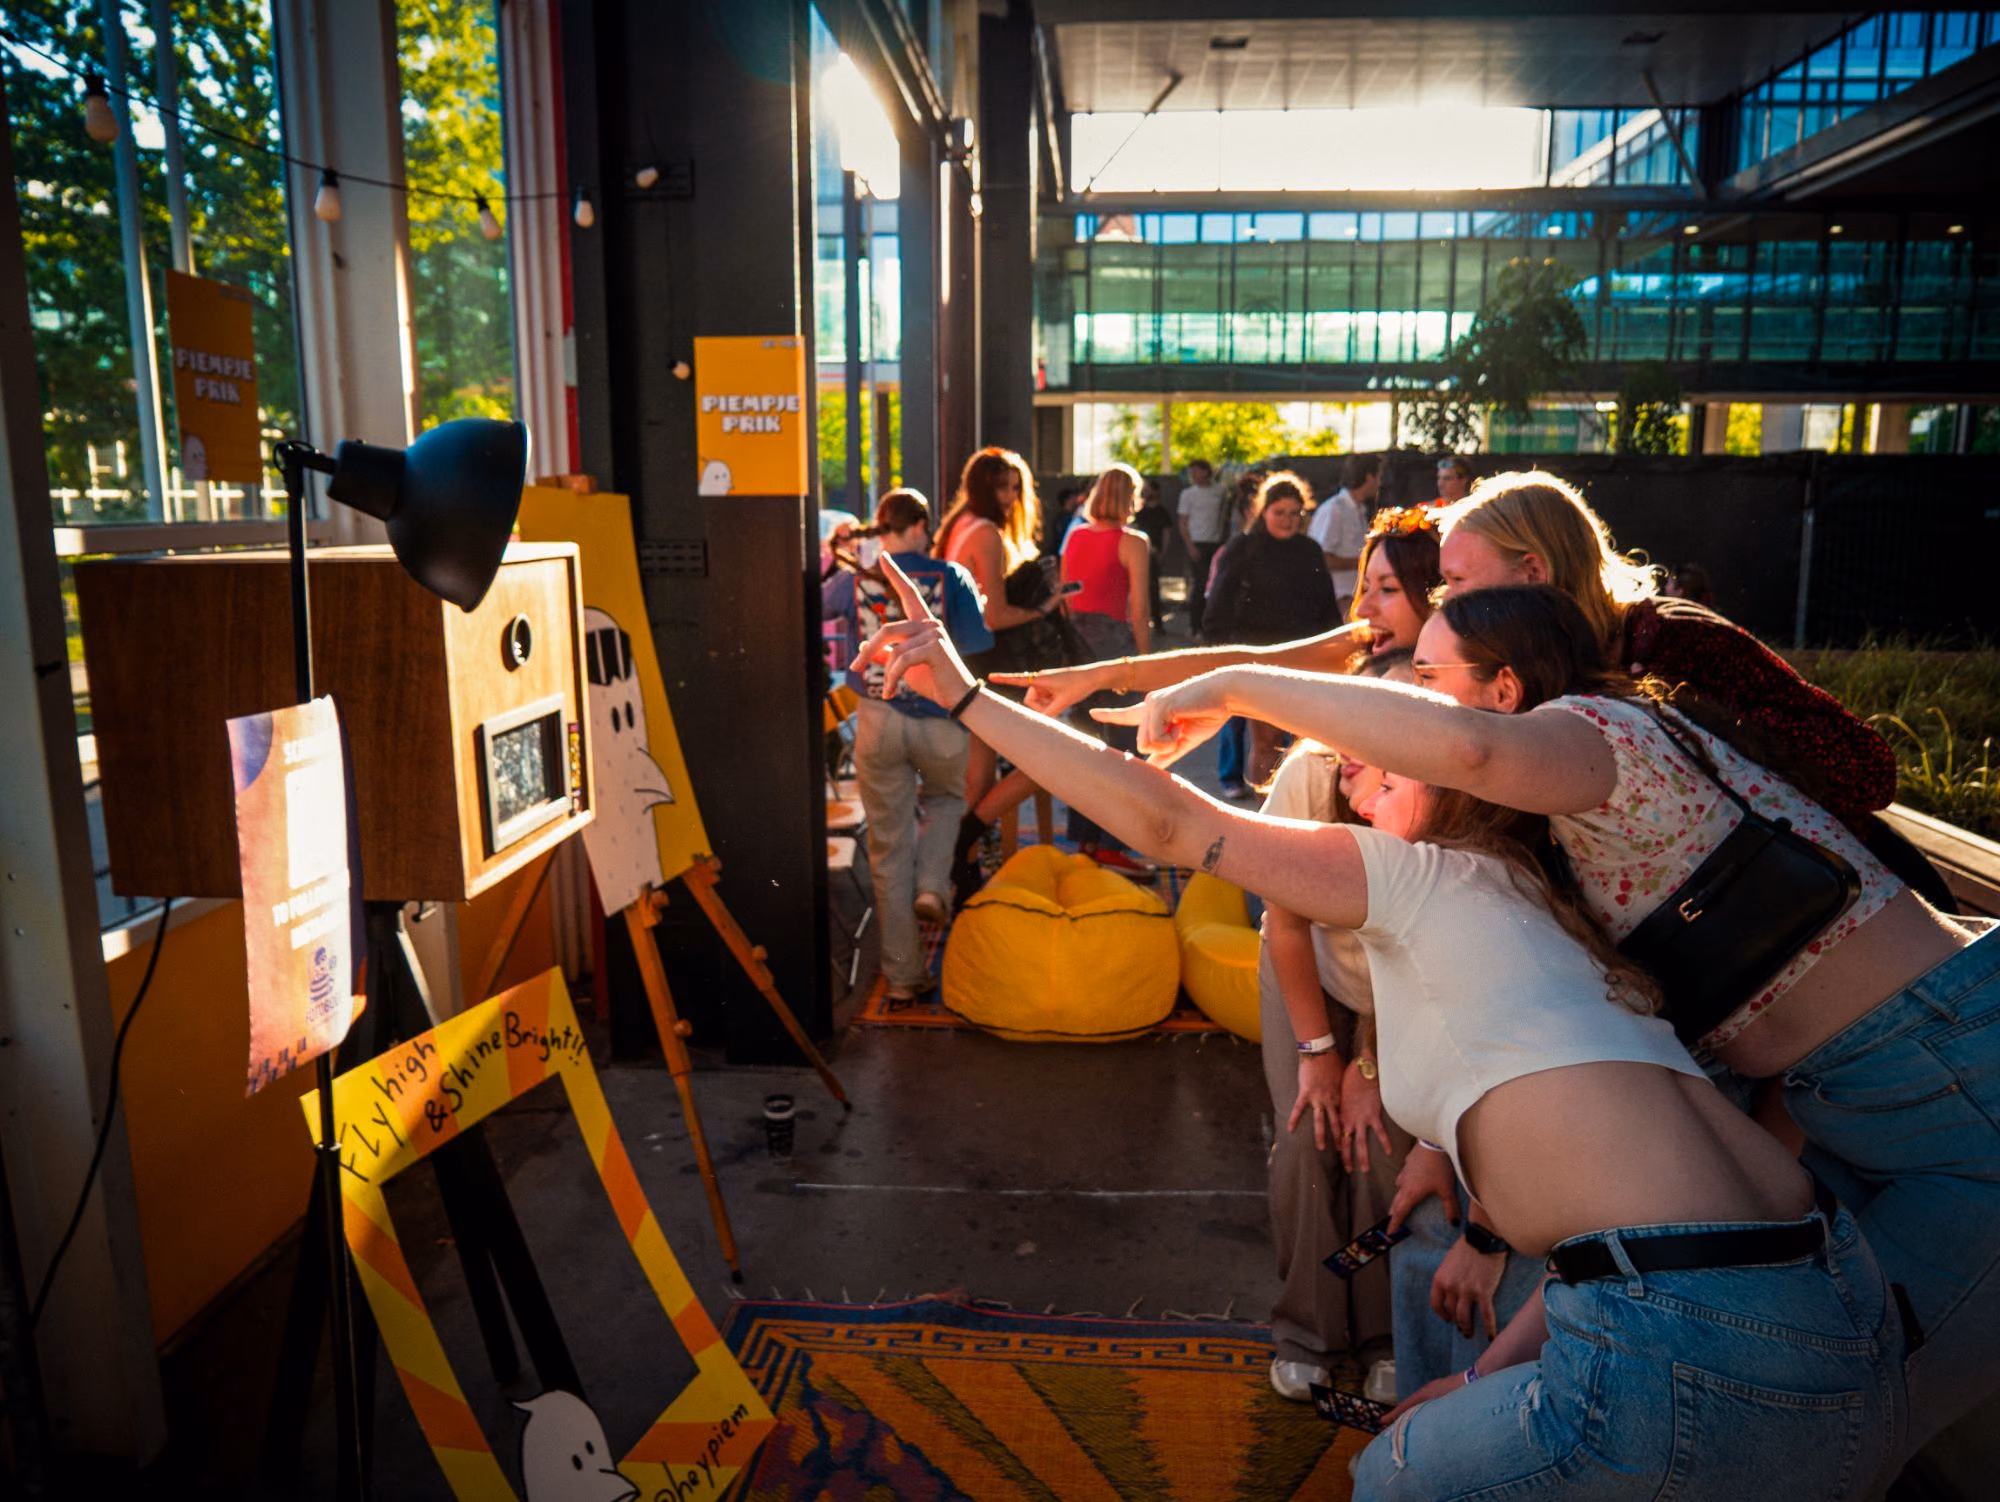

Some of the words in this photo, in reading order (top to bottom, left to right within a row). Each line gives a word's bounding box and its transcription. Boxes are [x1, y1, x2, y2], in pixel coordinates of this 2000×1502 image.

[194, 377, 241, 404] PRIK
[702, 394, 800, 414] PIEMPJE
[722, 415, 781, 433] PRIK
[371, 1039, 435, 1102] high
